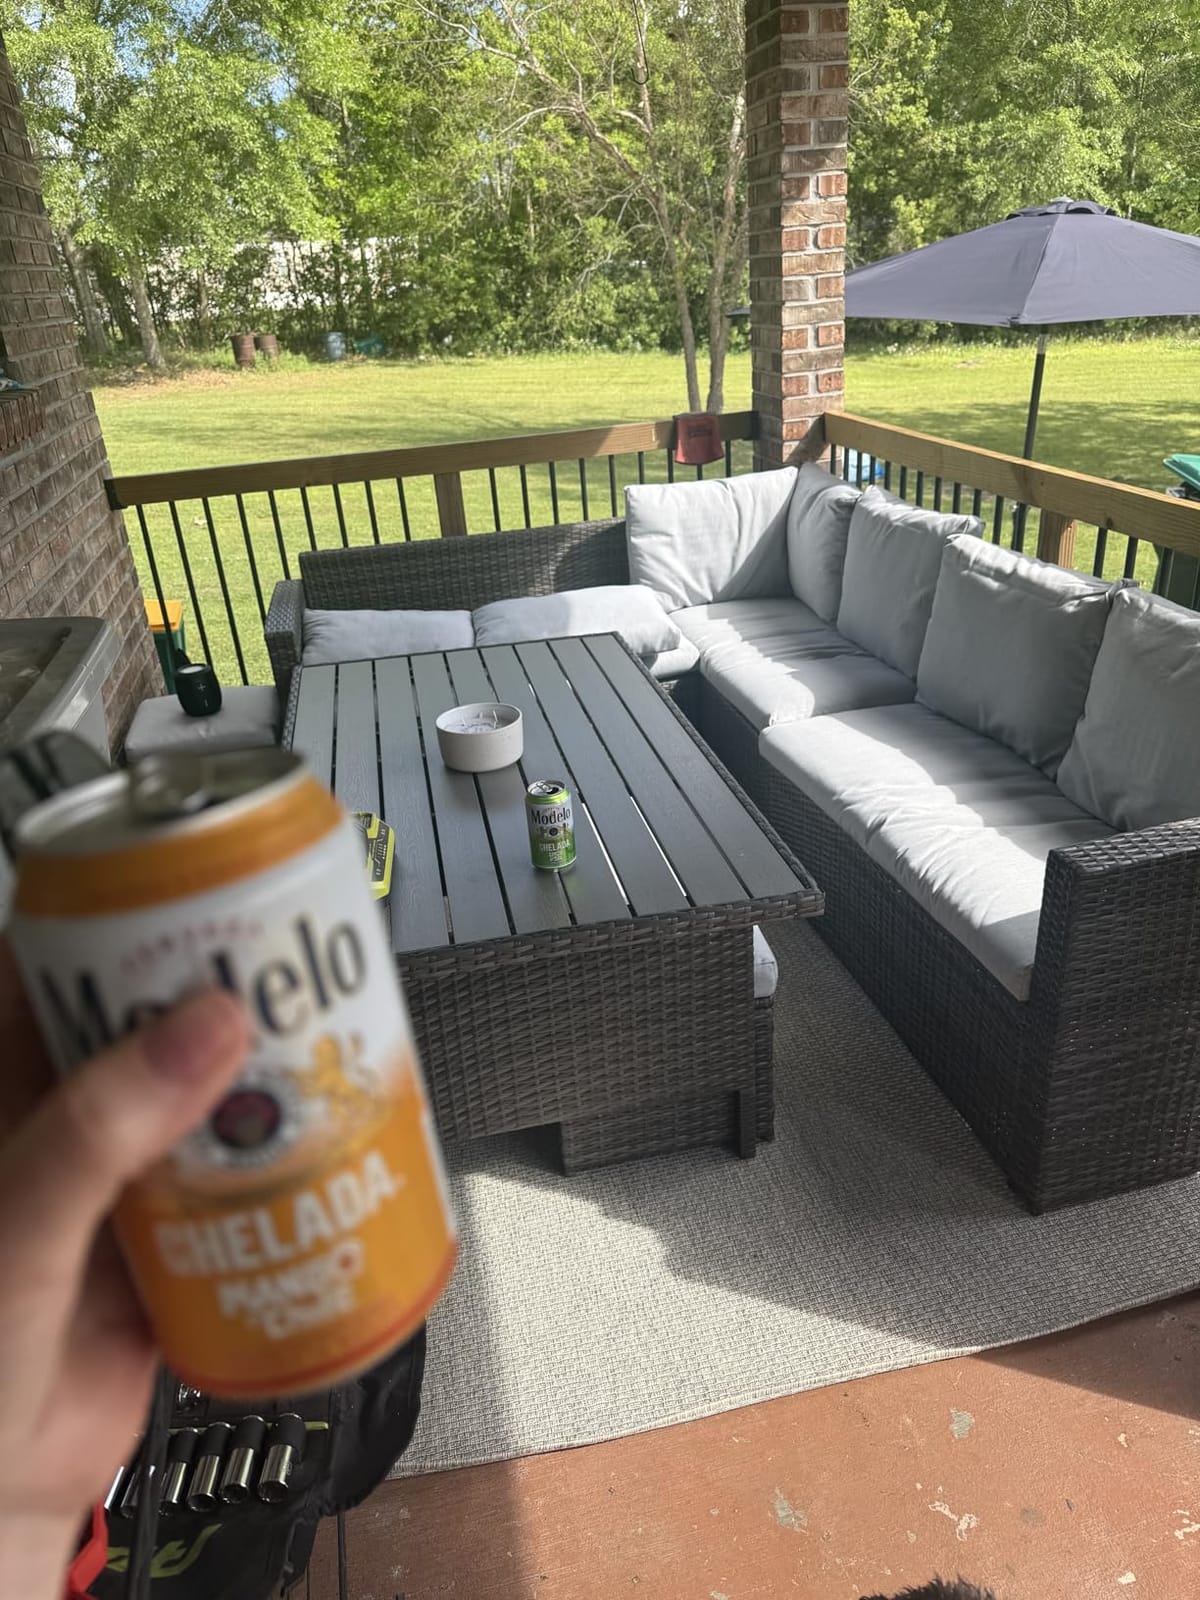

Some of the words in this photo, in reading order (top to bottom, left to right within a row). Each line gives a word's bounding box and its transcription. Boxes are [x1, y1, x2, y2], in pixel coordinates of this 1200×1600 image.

[531, 807, 571, 825] Modelo
[38, 914, 366, 1062] Melo
[155, 1150, 397, 1277] CHELADA
